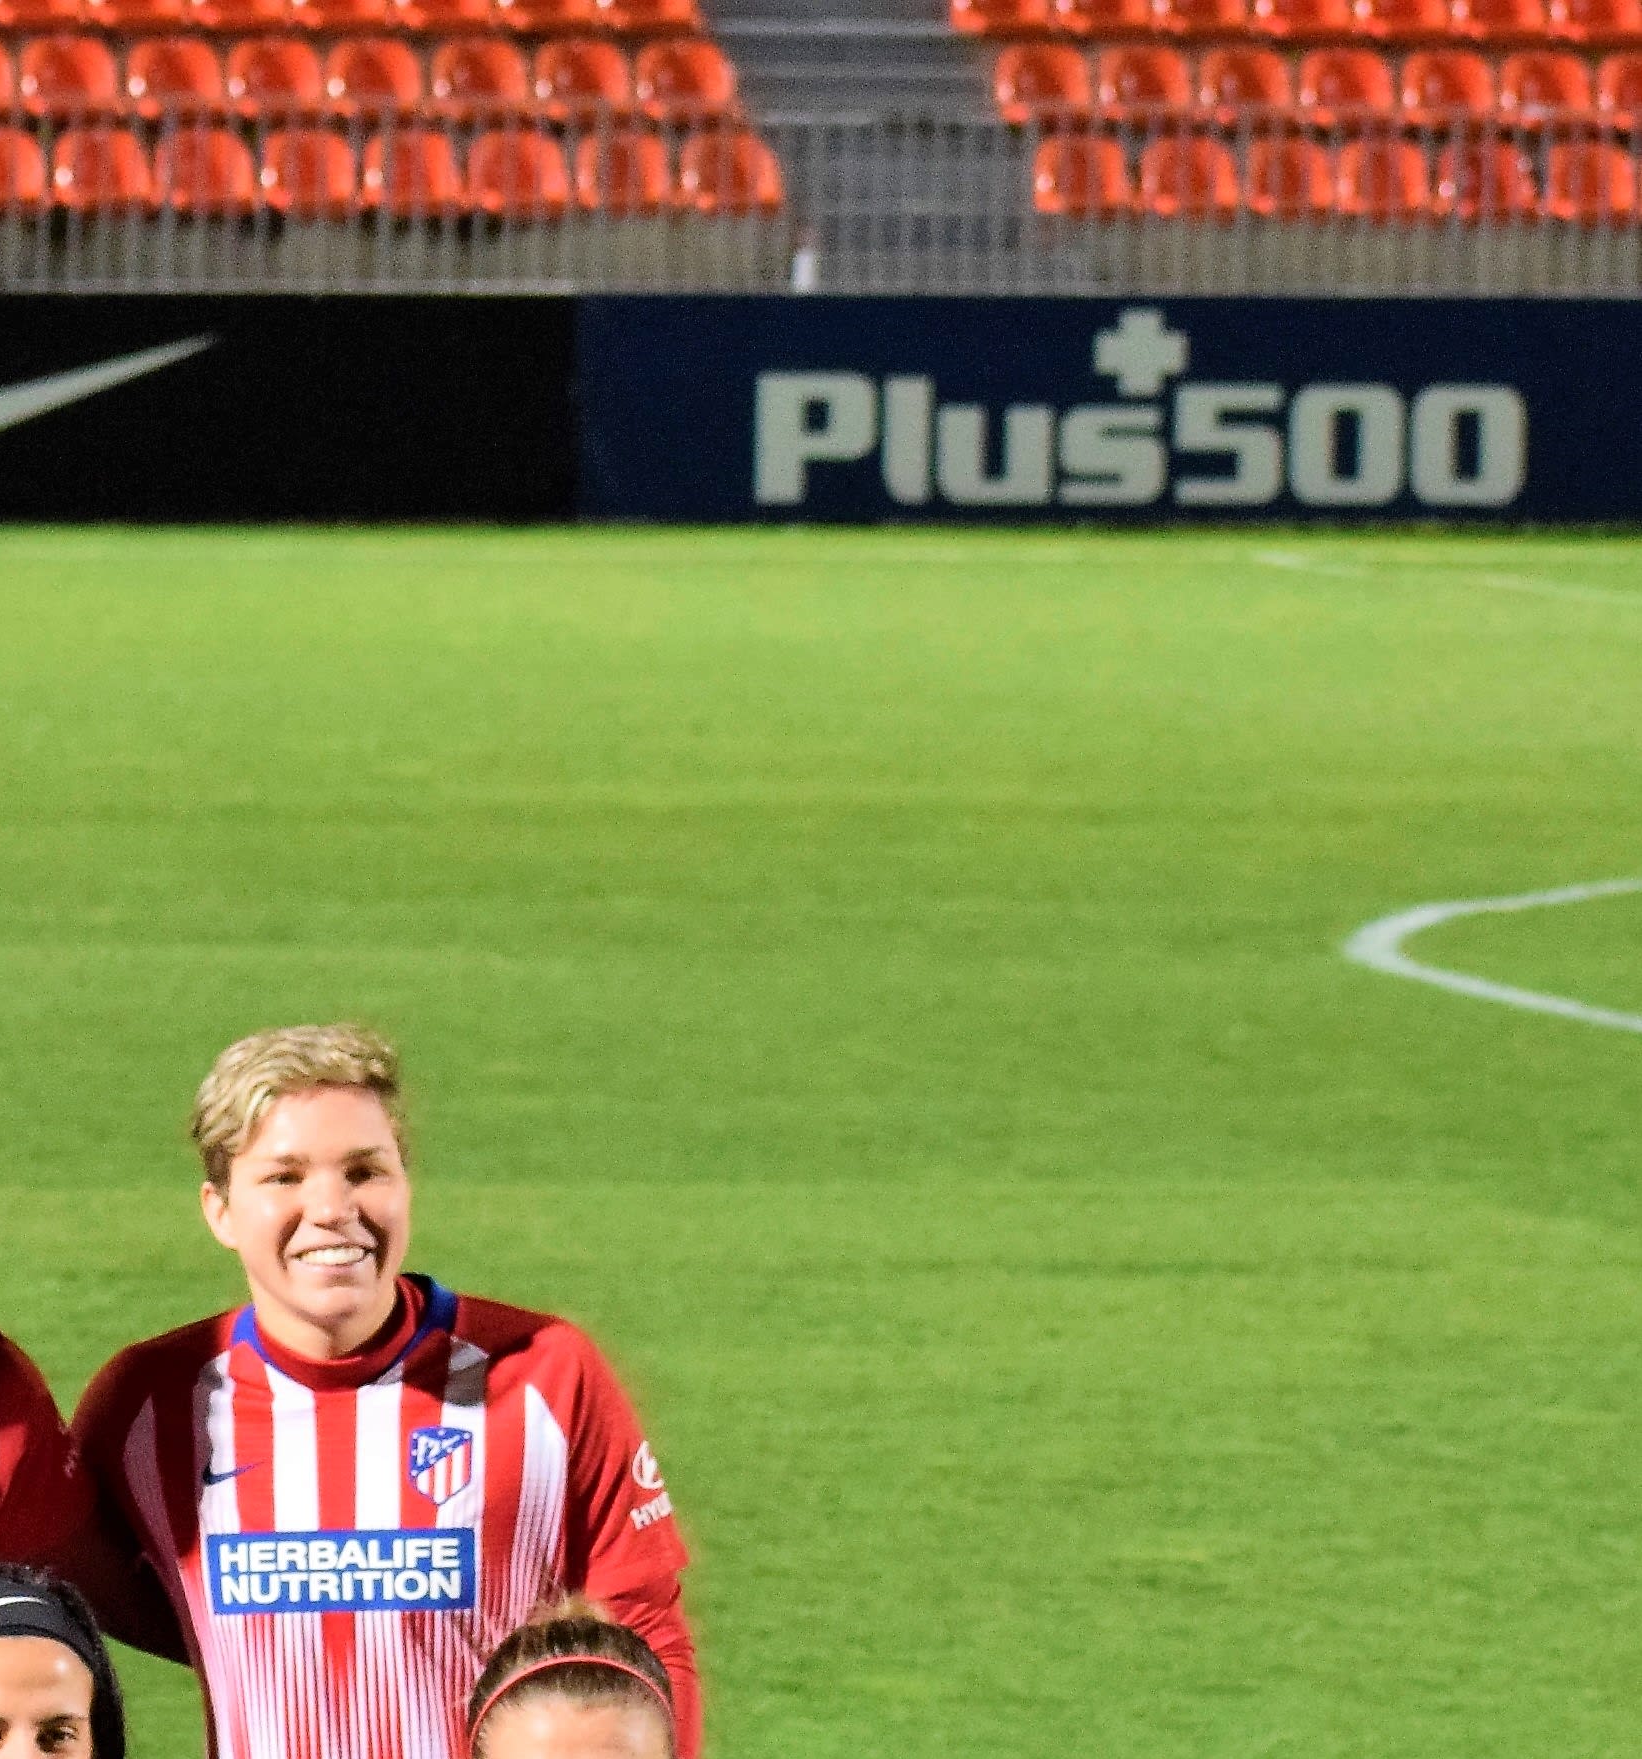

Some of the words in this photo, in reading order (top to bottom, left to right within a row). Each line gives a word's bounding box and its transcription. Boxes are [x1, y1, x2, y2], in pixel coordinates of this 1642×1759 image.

[754, 371, 1528, 507] Plus500
[218, 1537, 461, 1575] HERBALIFE
[220, 1569, 462, 1606] NUTRITION
